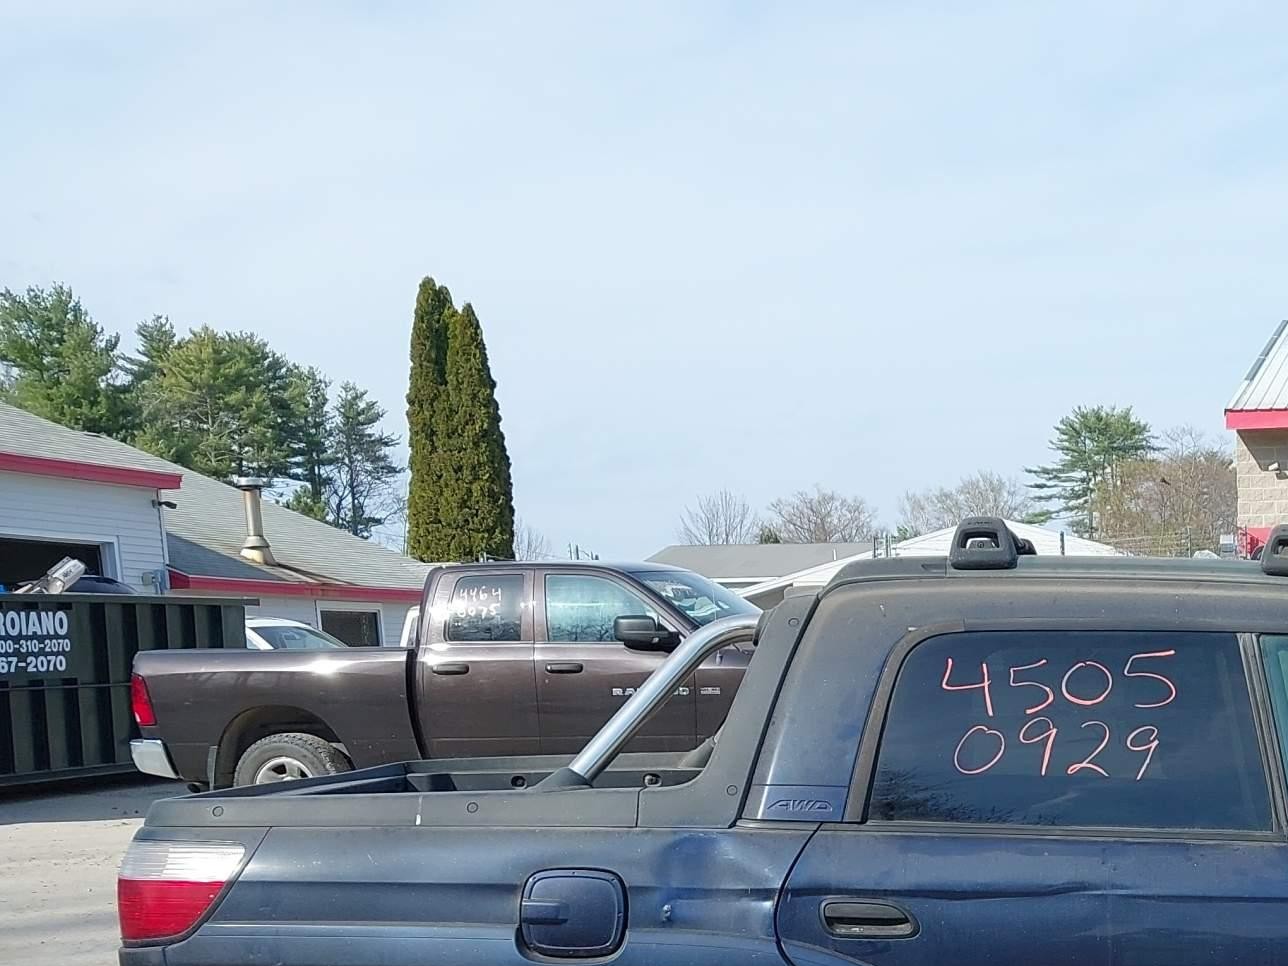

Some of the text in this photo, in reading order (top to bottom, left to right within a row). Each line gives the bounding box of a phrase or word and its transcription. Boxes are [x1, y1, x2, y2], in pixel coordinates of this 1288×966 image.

[942, 650, 1176, 717] 4505
[954, 716, 1160, 780] 0929
[767, 799, 833, 811] AWD
